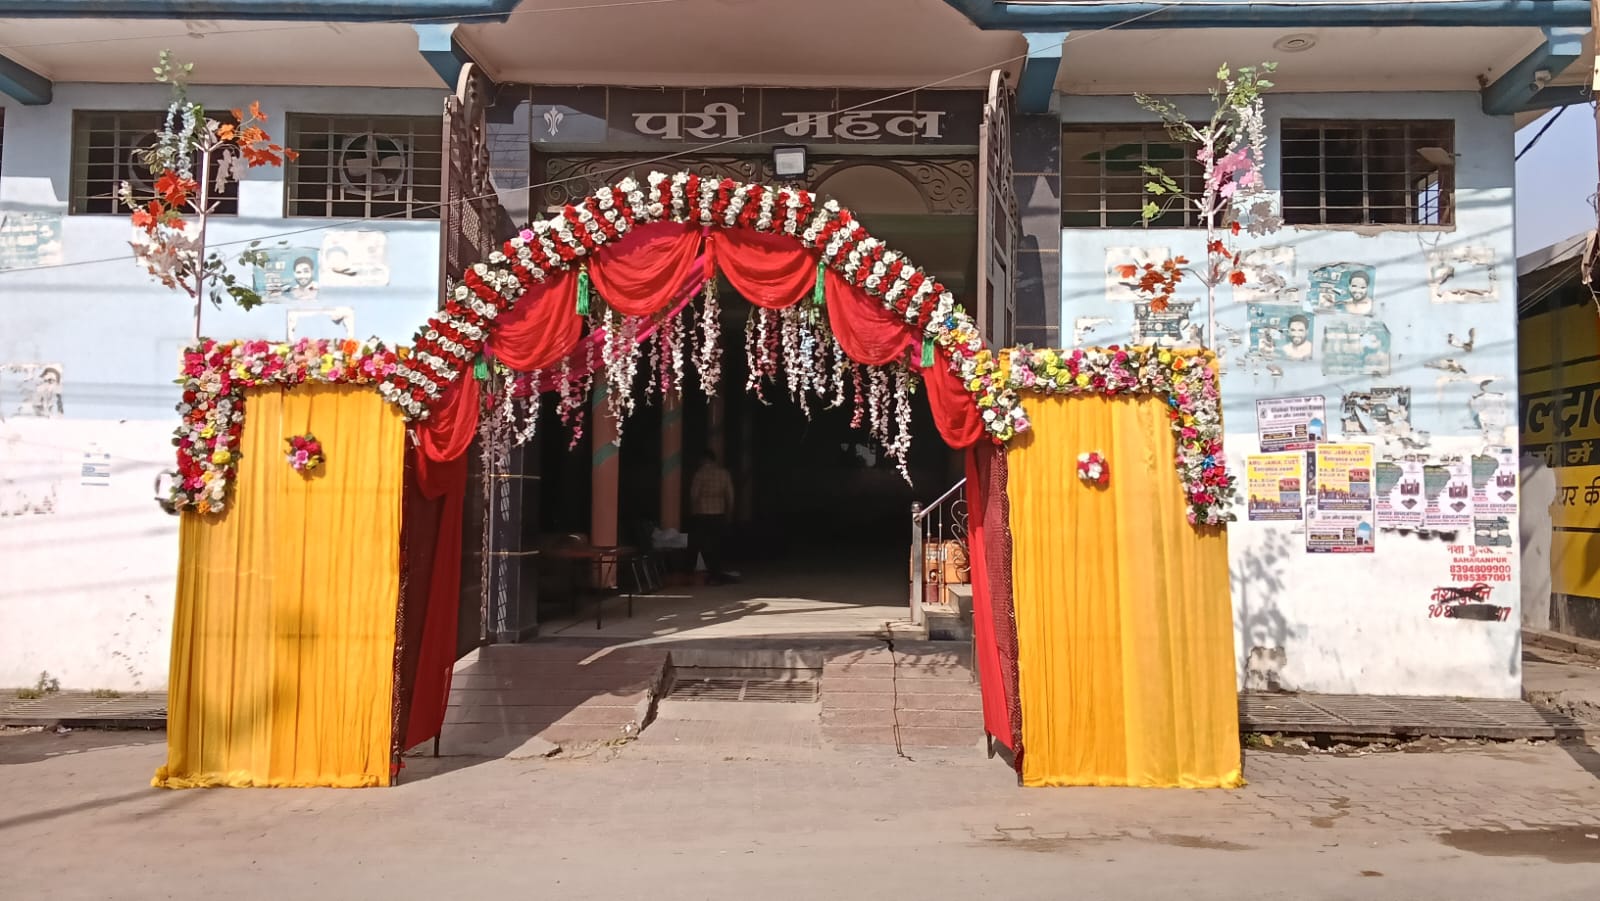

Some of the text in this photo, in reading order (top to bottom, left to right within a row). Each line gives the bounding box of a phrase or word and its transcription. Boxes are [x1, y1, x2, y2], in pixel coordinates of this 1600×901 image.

[632, 102, 945, 140] परी महल
[1450, 565, 1511, 573] 8394809900
